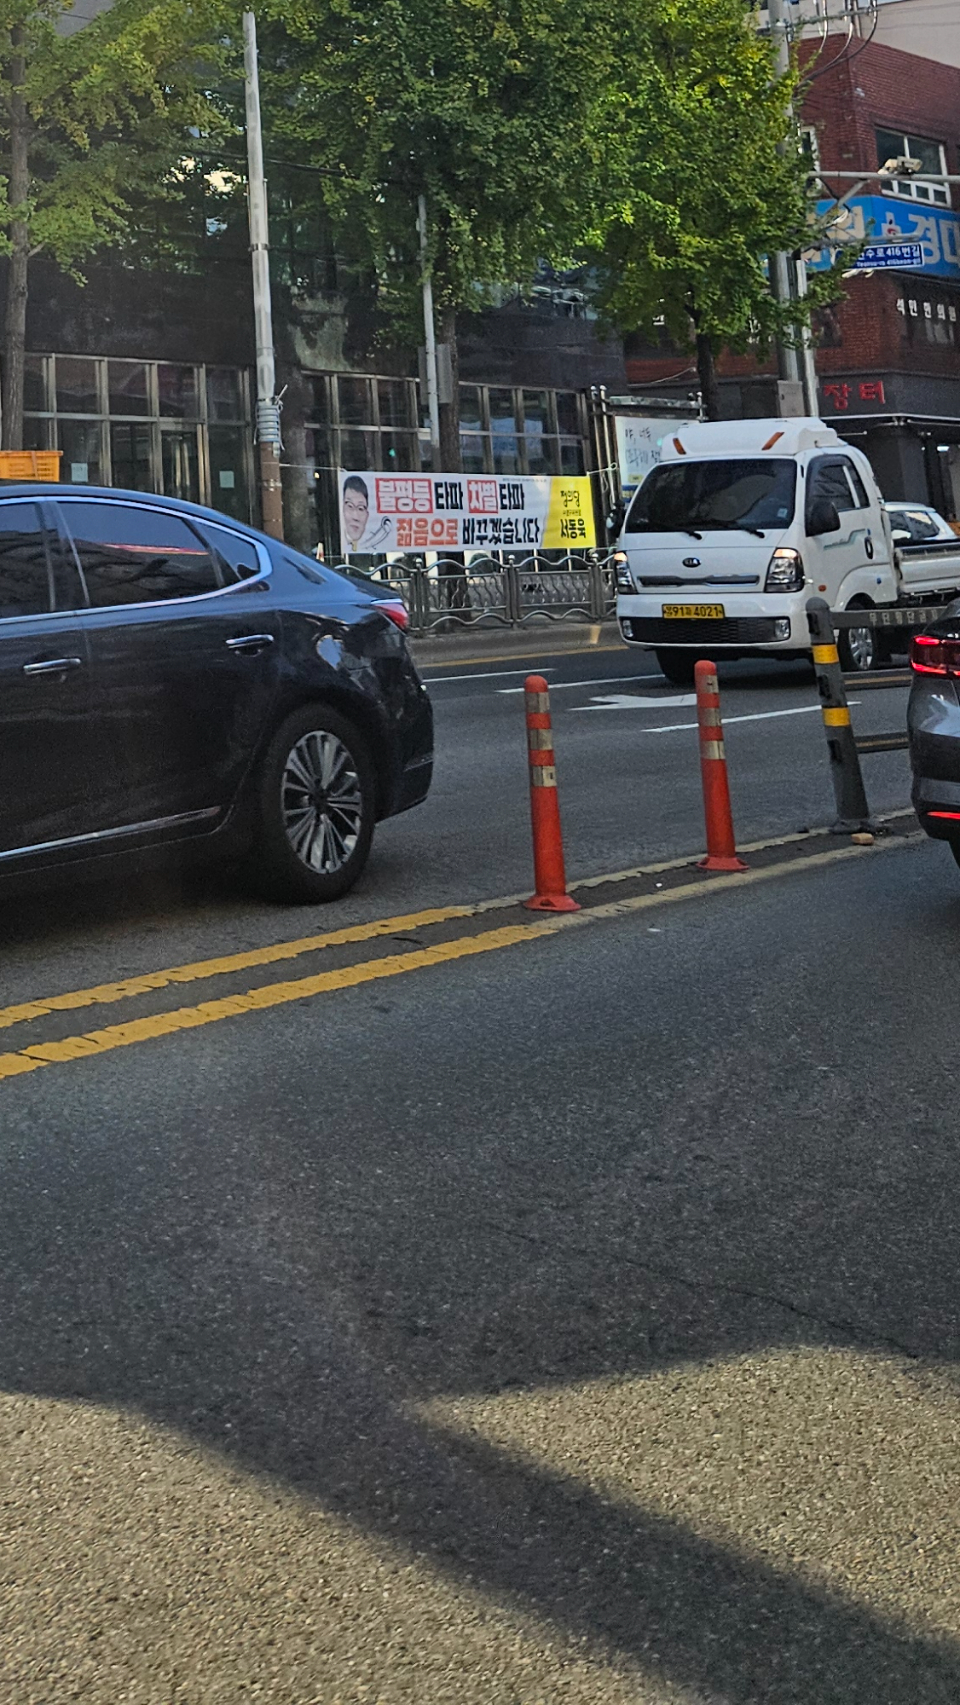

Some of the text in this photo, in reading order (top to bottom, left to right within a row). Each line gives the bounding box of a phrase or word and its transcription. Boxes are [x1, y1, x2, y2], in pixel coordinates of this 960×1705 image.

[376, 479, 525, 513] 불평등 타파 차별 타파
[396, 517, 540, 547] 젊음으로 바꾸겠습니다
[560, 518, 586, 539] 서동욱
[694, 606, 719, 617] 4021
